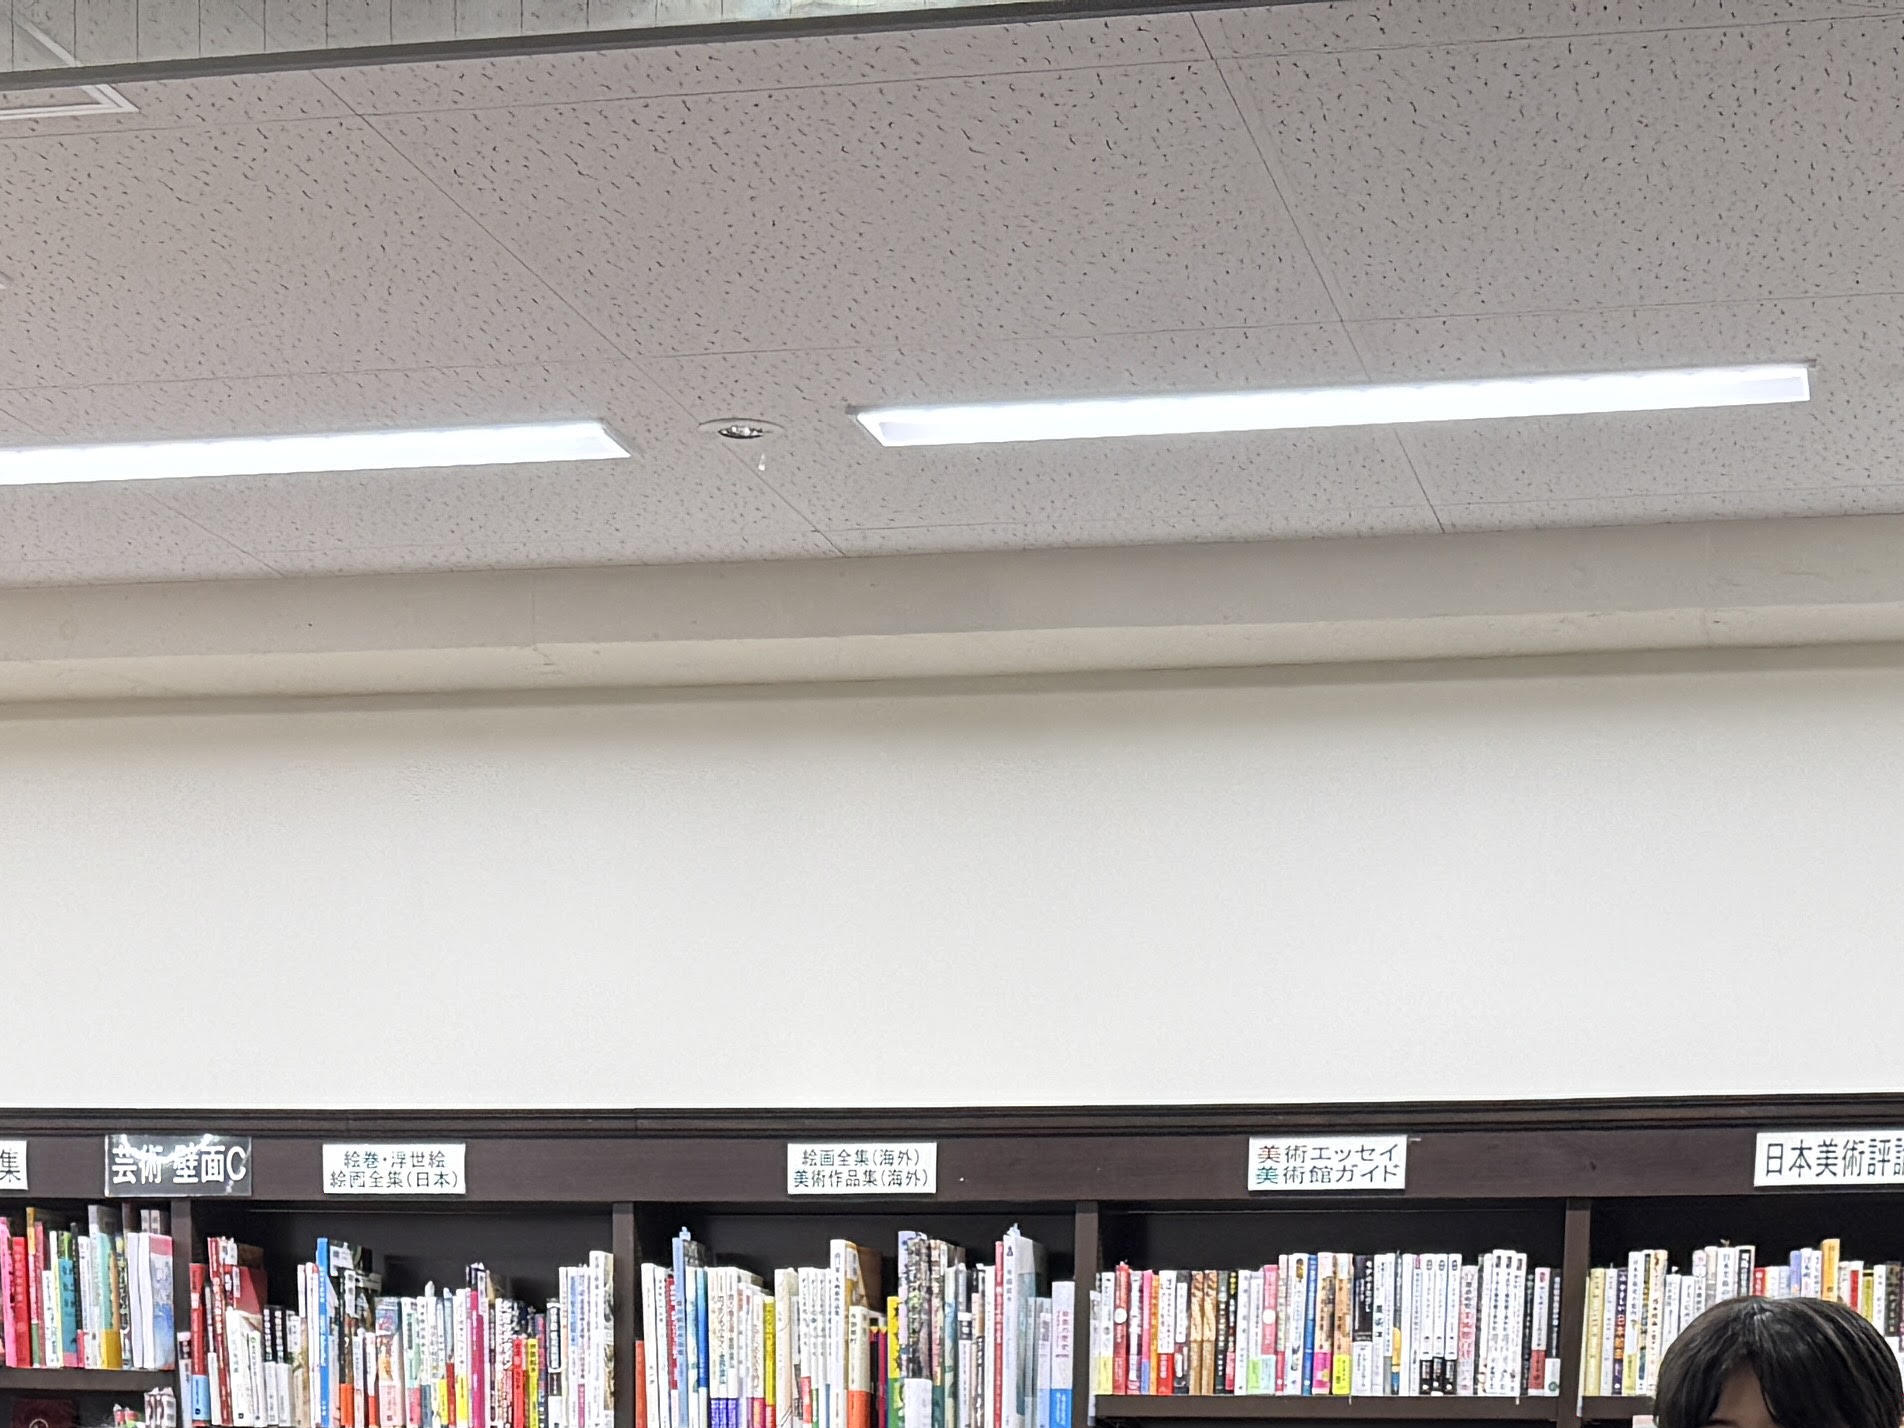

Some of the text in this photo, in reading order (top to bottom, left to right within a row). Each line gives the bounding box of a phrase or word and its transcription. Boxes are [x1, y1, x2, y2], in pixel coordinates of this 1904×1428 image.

[344, 1150, 446, 1169] 絵巻・浮世絵
[1258, 1144, 1399, 1163] 美術エッセイ
[1256, 1164, 1400, 1184] 美術館ガイド
